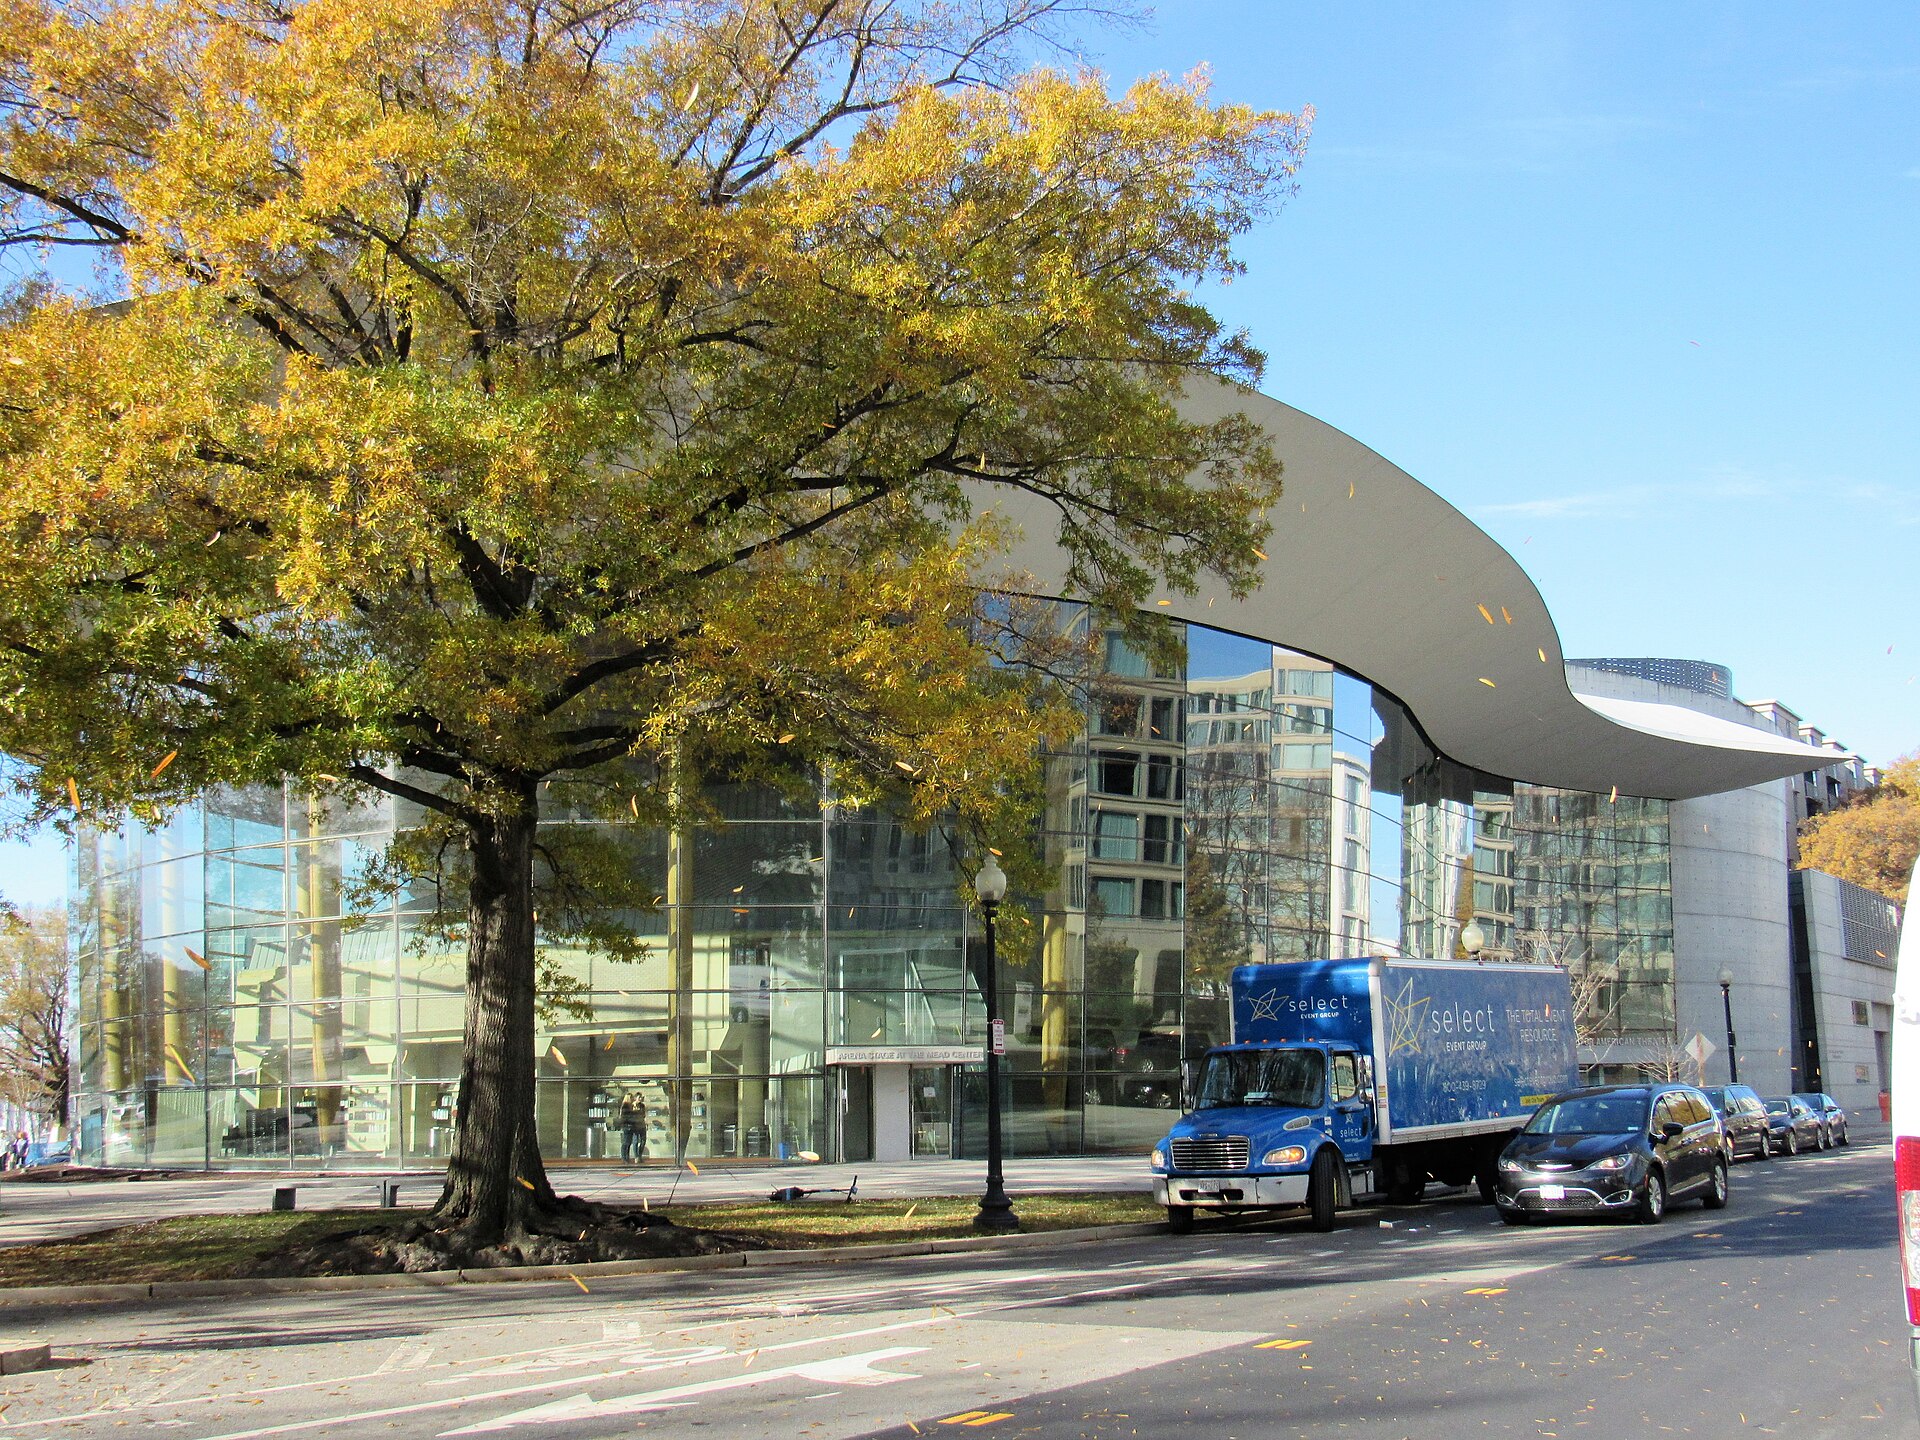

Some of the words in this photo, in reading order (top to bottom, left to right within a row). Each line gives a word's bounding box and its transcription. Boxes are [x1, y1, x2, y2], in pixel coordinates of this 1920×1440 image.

[1289, 995, 1349, 1012] select
[1431, 1001, 1495, 1033] select
[1505, 1009, 1521, 1023] THE
[1521, 1009, 1544, 1023] TOTAL
[1520, 1028, 1558, 1042] RESOURCE
[1446, 1042, 1466, 1052] EVENT
[1466, 1041, 1487, 1051] GROUP
[1596, 1037, 1635, 1046] AMERICAN
[838, 1052, 867, 1060] ARENA
[868, 1051, 895, 1060] STAGE
[896, 1051, 908, 1059] AT
[926, 1051, 951, 1059] MEAD
[951, 1050, 983, 1059] CENTER
[1340, 1127, 1362, 1138] select
